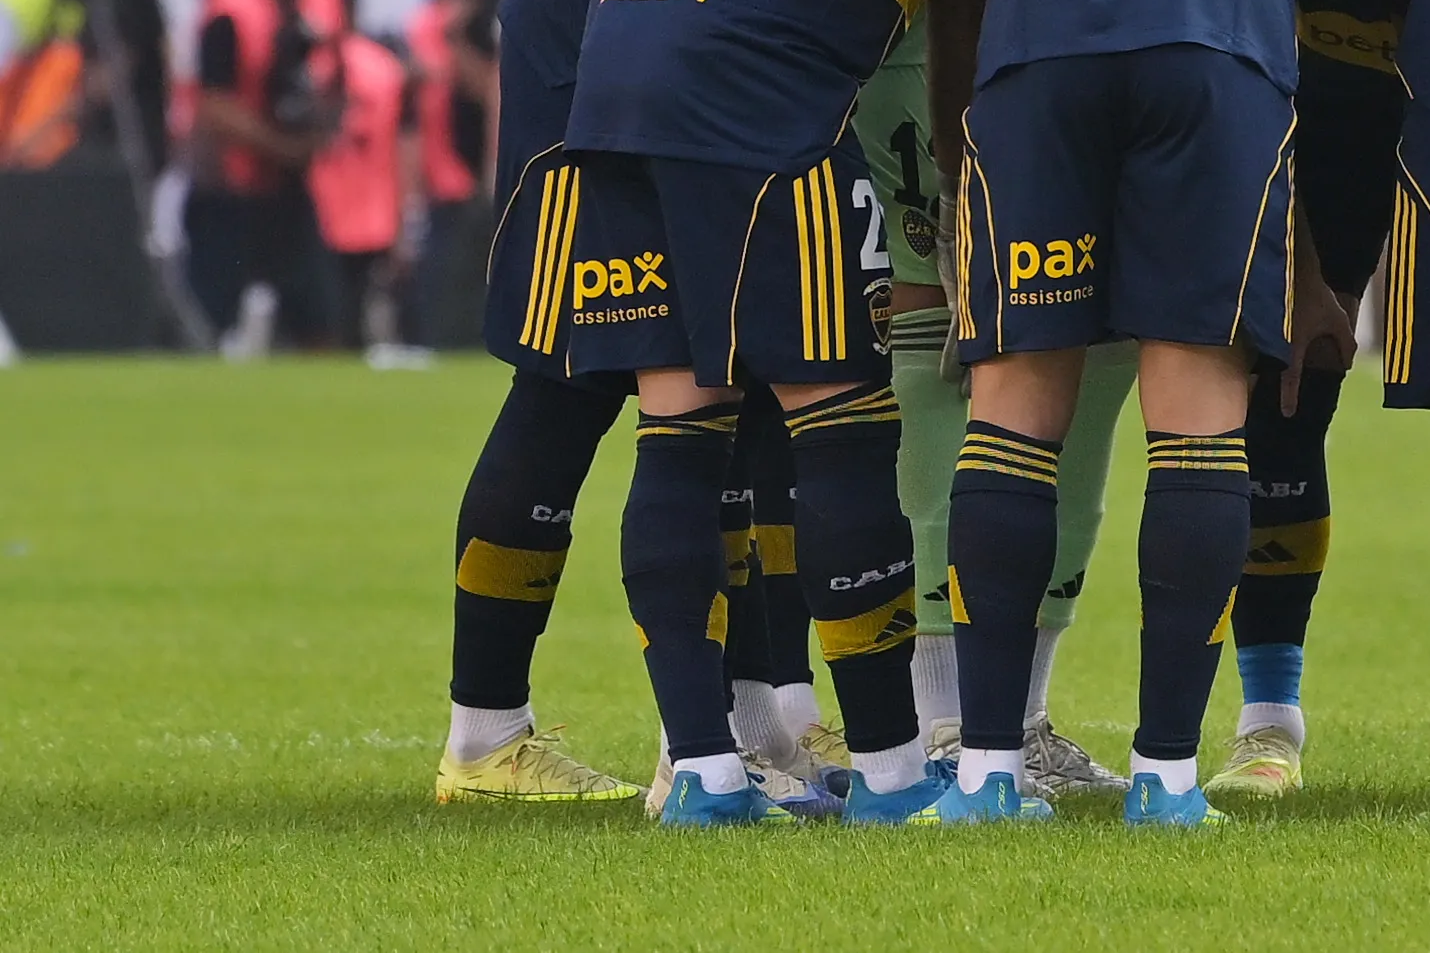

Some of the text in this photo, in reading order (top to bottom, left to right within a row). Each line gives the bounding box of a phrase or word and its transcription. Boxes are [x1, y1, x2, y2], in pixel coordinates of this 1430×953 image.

[572, 250, 668, 310] pax
[1008, 232, 1097, 290] pax
[572, 302, 670, 326] assistance
[1008, 283, 1095, 306] assistance
